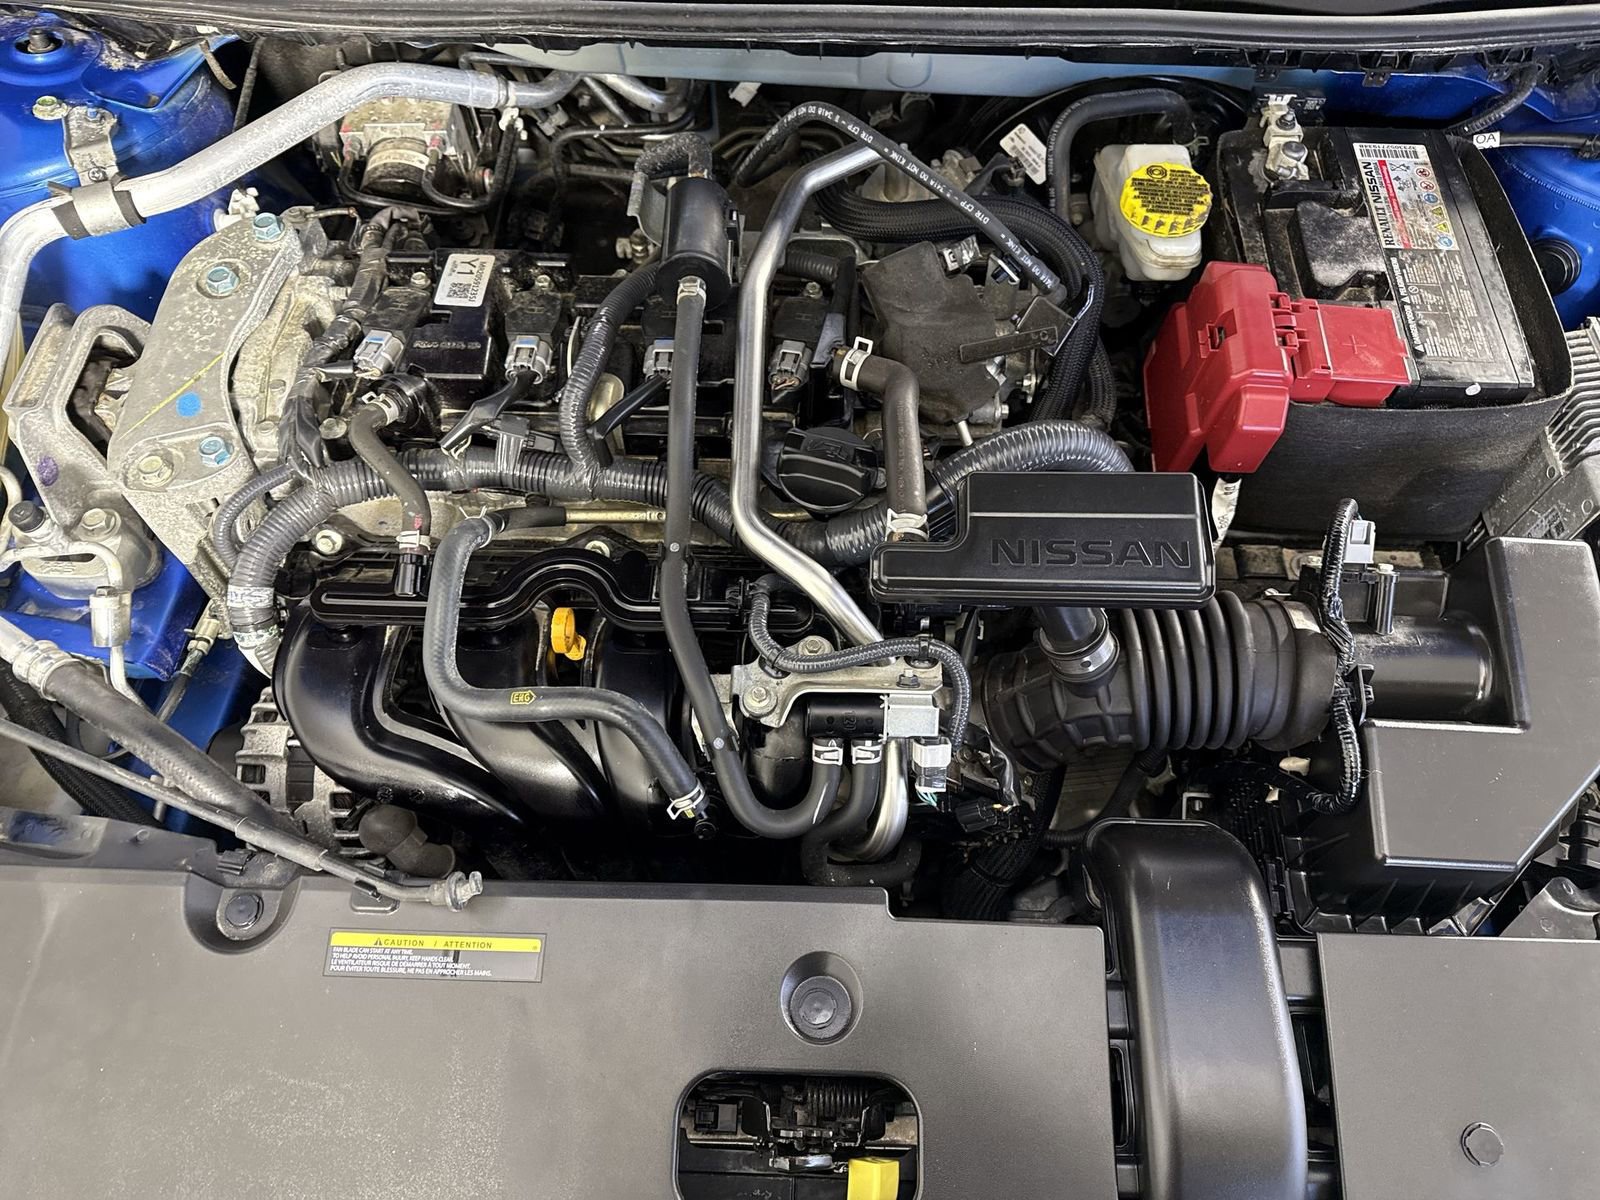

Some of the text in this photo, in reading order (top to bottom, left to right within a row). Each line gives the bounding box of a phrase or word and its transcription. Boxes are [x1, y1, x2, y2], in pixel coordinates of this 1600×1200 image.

[860, 131, 873, 143] DTR
[890, 151, 906, 165] KINK
[906, 163, 919, 174] NOT
[919, 171, 929, 182] DO
[1361, 162, 1383, 204] NISSAN
[960, 201, 975, 212] CFP
[975, 210, 990, 224] DTR
[1375, 205, 1395, 246] RENAULT
[1006, 238, 1021, 255] KINK
[456, 257, 480, 275] Y1
[1020, 255, 1033, 267] NOT
[991, 539, 1191, 568] NISSAN
[384, 939, 425, 947] CAUTION
[444, 941, 492, 949] ATTENTION
